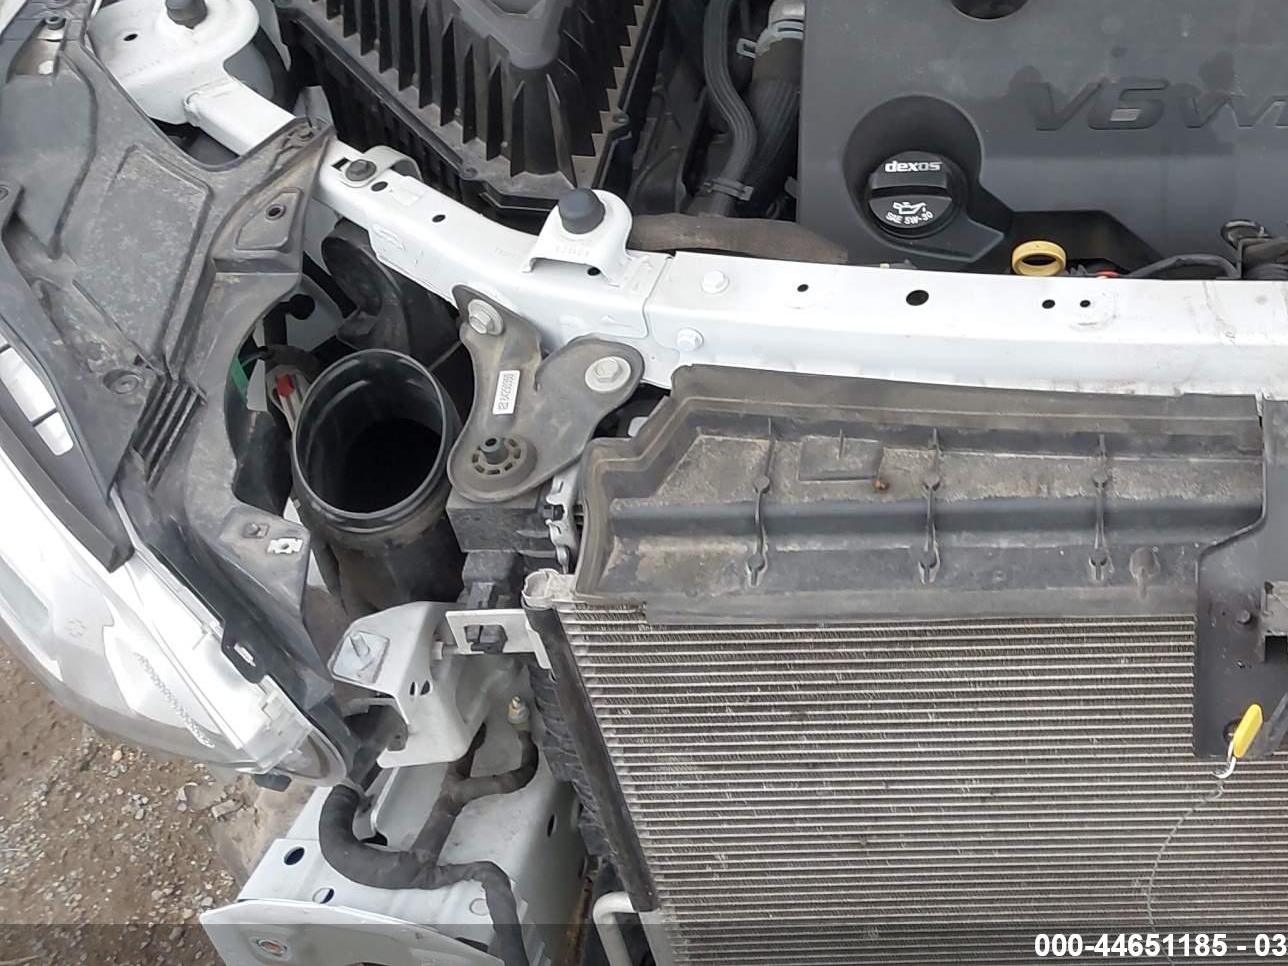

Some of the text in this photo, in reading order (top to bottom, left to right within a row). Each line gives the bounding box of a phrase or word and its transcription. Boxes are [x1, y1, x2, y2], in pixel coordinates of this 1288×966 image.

[1024, 77, 1170, 131] V6
[885, 160, 944, 173] dexos
[885, 211, 934, 225] SAE 5W-30
